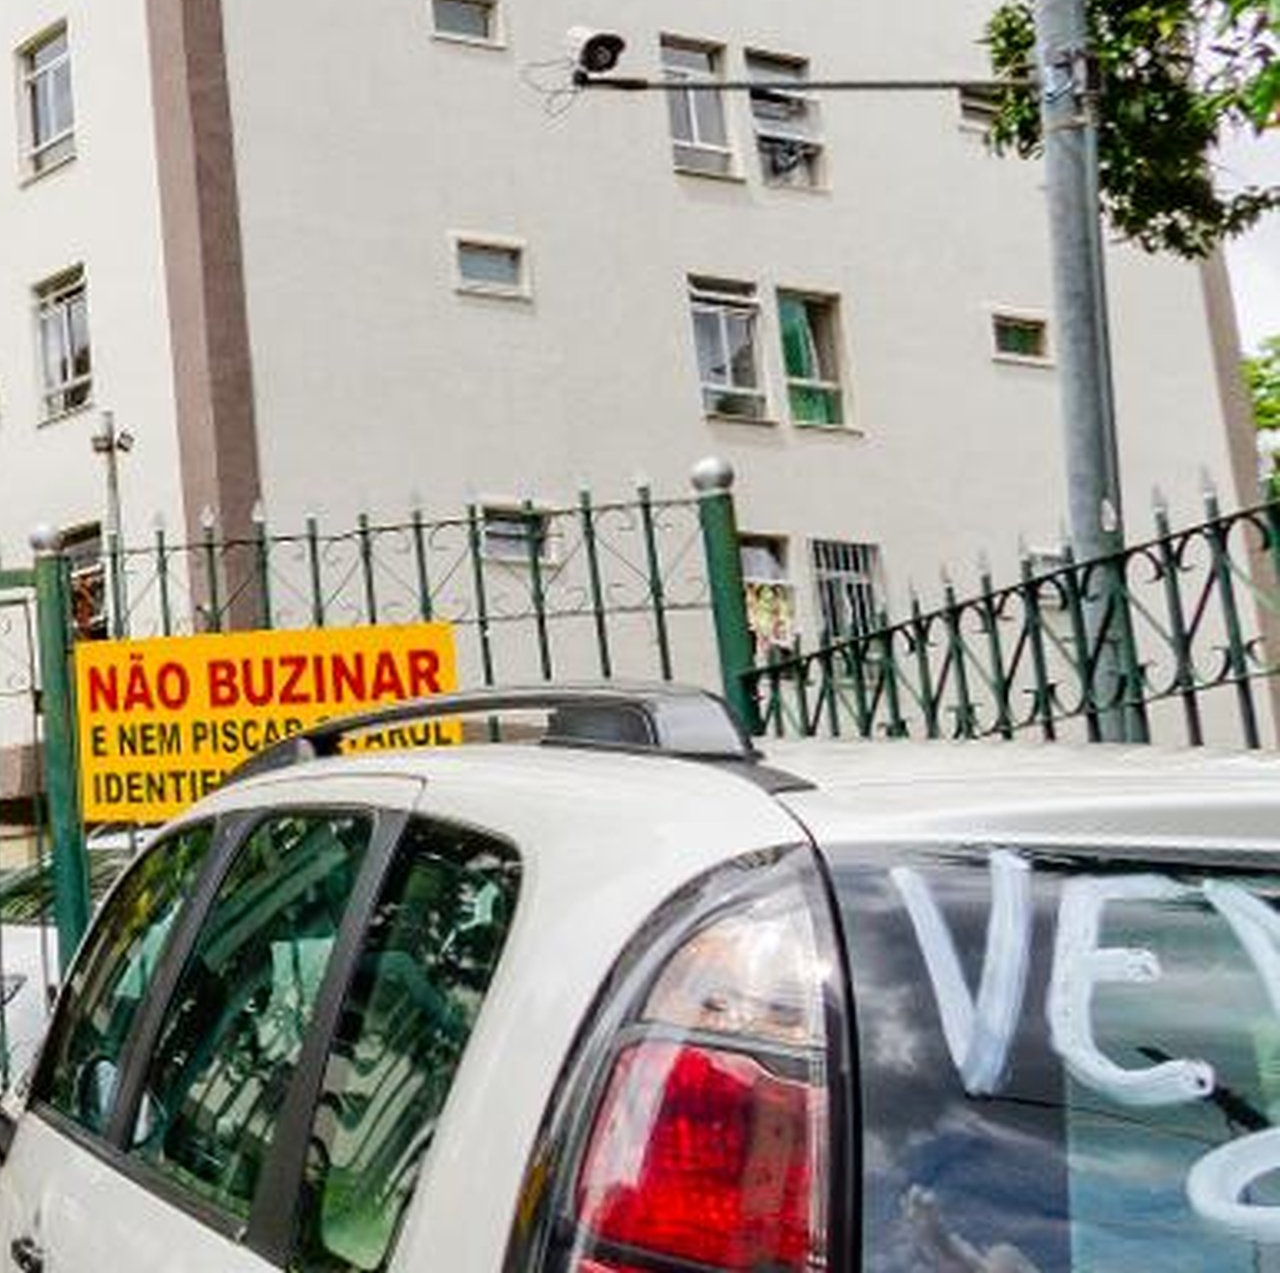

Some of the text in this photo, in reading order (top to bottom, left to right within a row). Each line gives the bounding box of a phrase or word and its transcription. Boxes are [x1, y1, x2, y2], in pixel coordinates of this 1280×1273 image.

[88, 649, 441, 712] NÃO BUZINAR
[93, 728, 108, 756] E
[119, 722, 181, 755] NEM
[346, 720, 453, 748] AROL
[95, 768, 227, 804] IDENTIF
